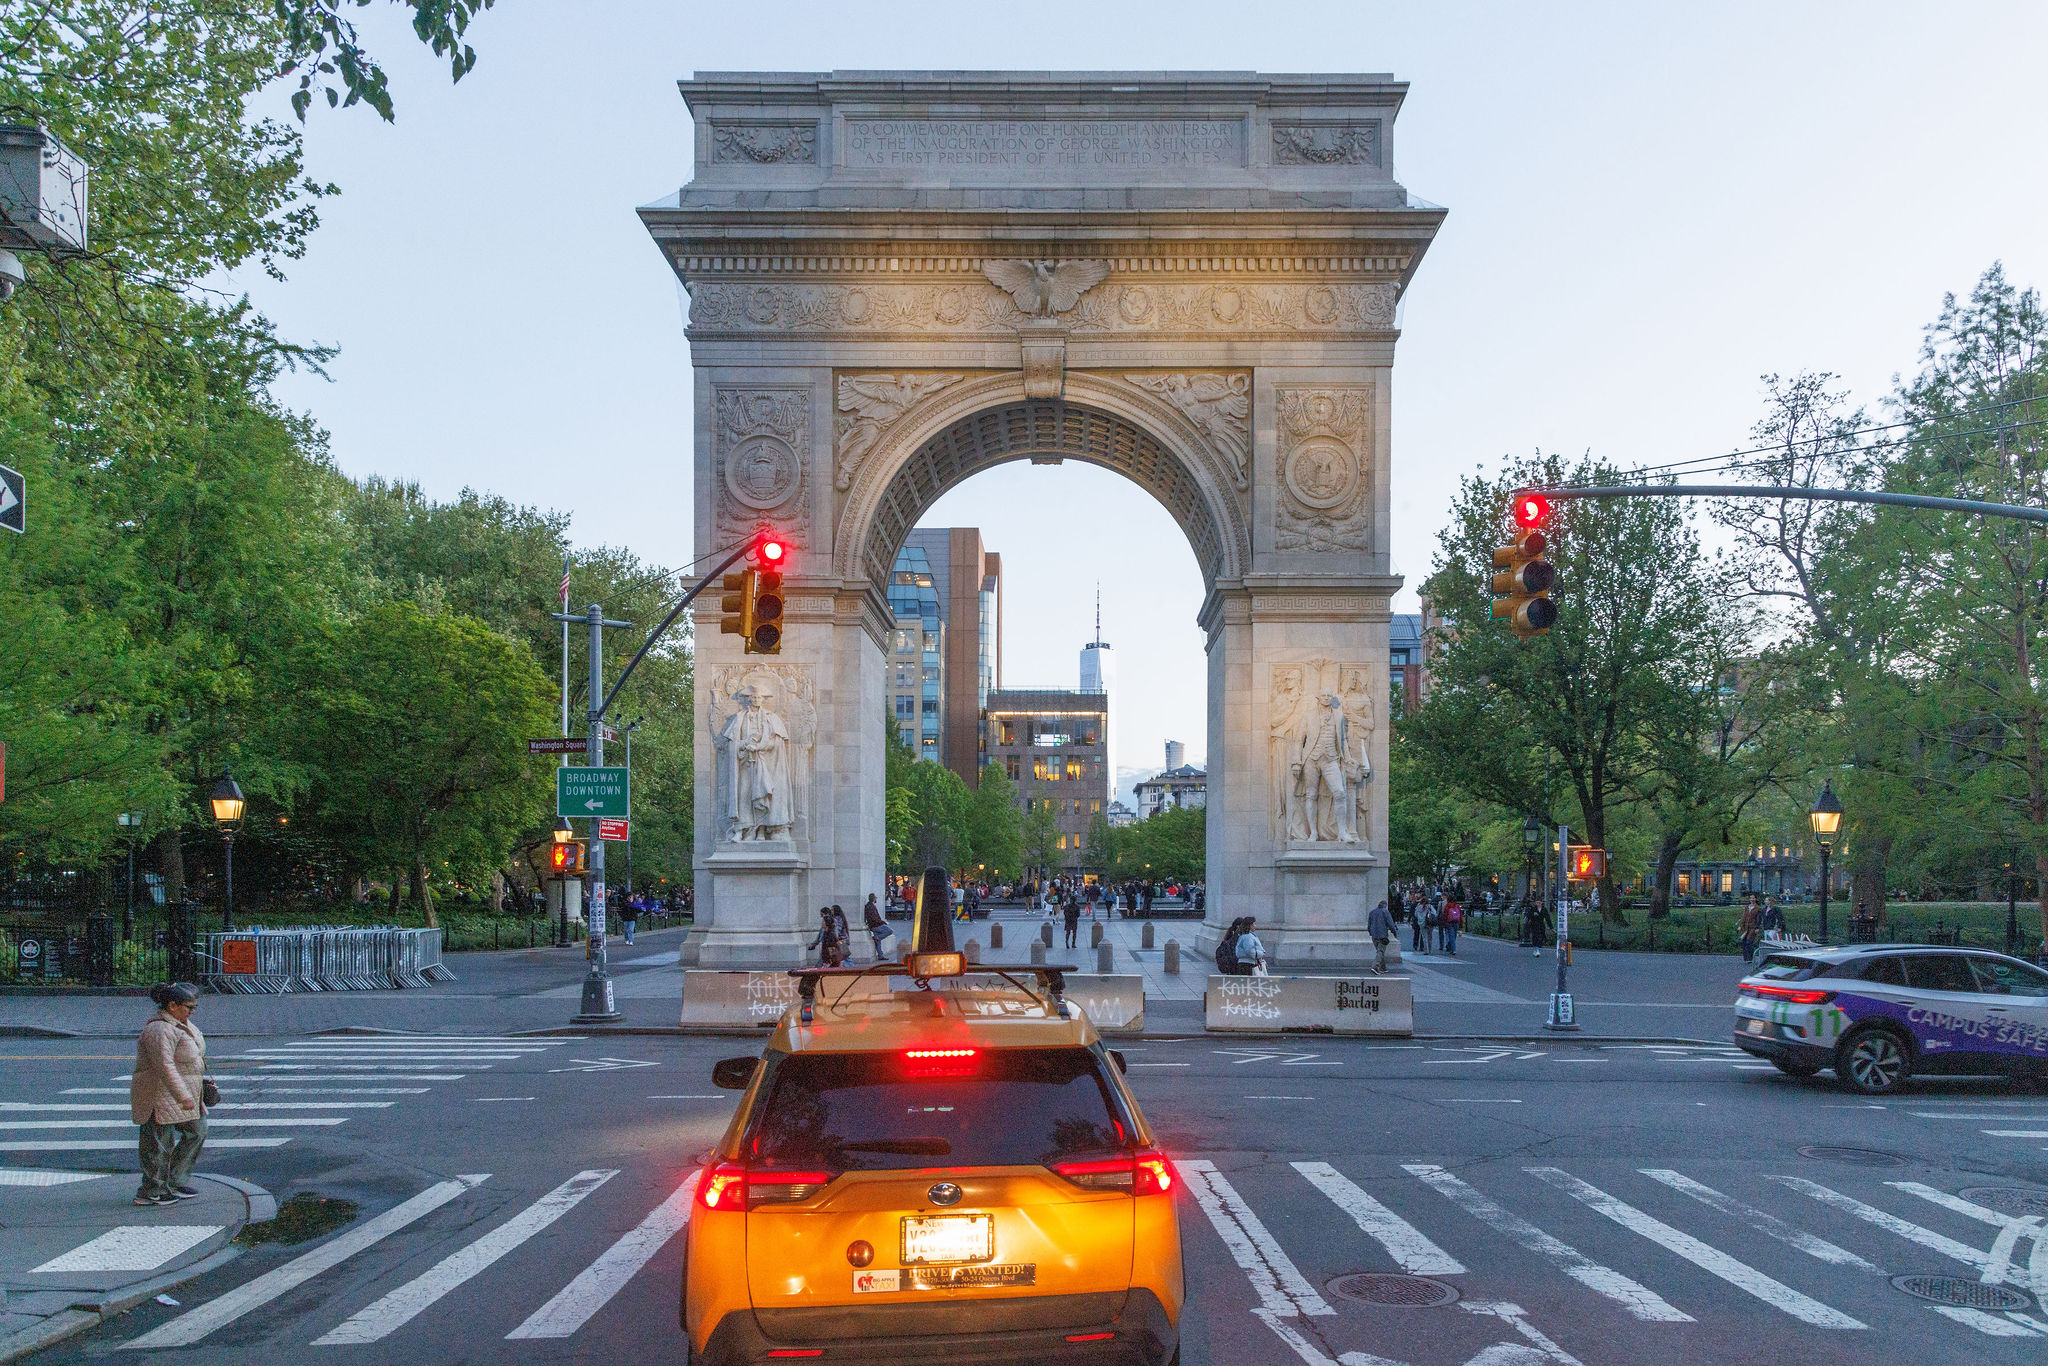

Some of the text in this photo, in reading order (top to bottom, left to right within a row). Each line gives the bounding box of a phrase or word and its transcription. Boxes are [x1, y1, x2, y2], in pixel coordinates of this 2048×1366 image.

[851, 123, 1235, 136] TO COMMEMORATE THE ONE HUNDREDTH ANNIVERSARY
[852, 138, 1234, 150] OF THE INAUGURATION OF GEORGE WASHINGTON
[865, 152, 1224, 164] AS FIRST PRESIDENT OF THE UNITED STATES
[530, 741, 587, 751] Washington Square
[566, 773, 620, 783] BROADWAY
[565, 785, 621, 795] DOWNTOWN
[1337, 980, 1379, 997] Parlay
[1336, 996, 1379, 1012] Parlay
[1810, 1009, 1841, 1037] 11
[1907, 1007, 2046, 1051] CAMPUS SAFE
[967, 1264, 1025, 1276] WANTED!
[874, 1280, 896, 1290] TAXI
[979, 1275, 1000, 1283] Queens
